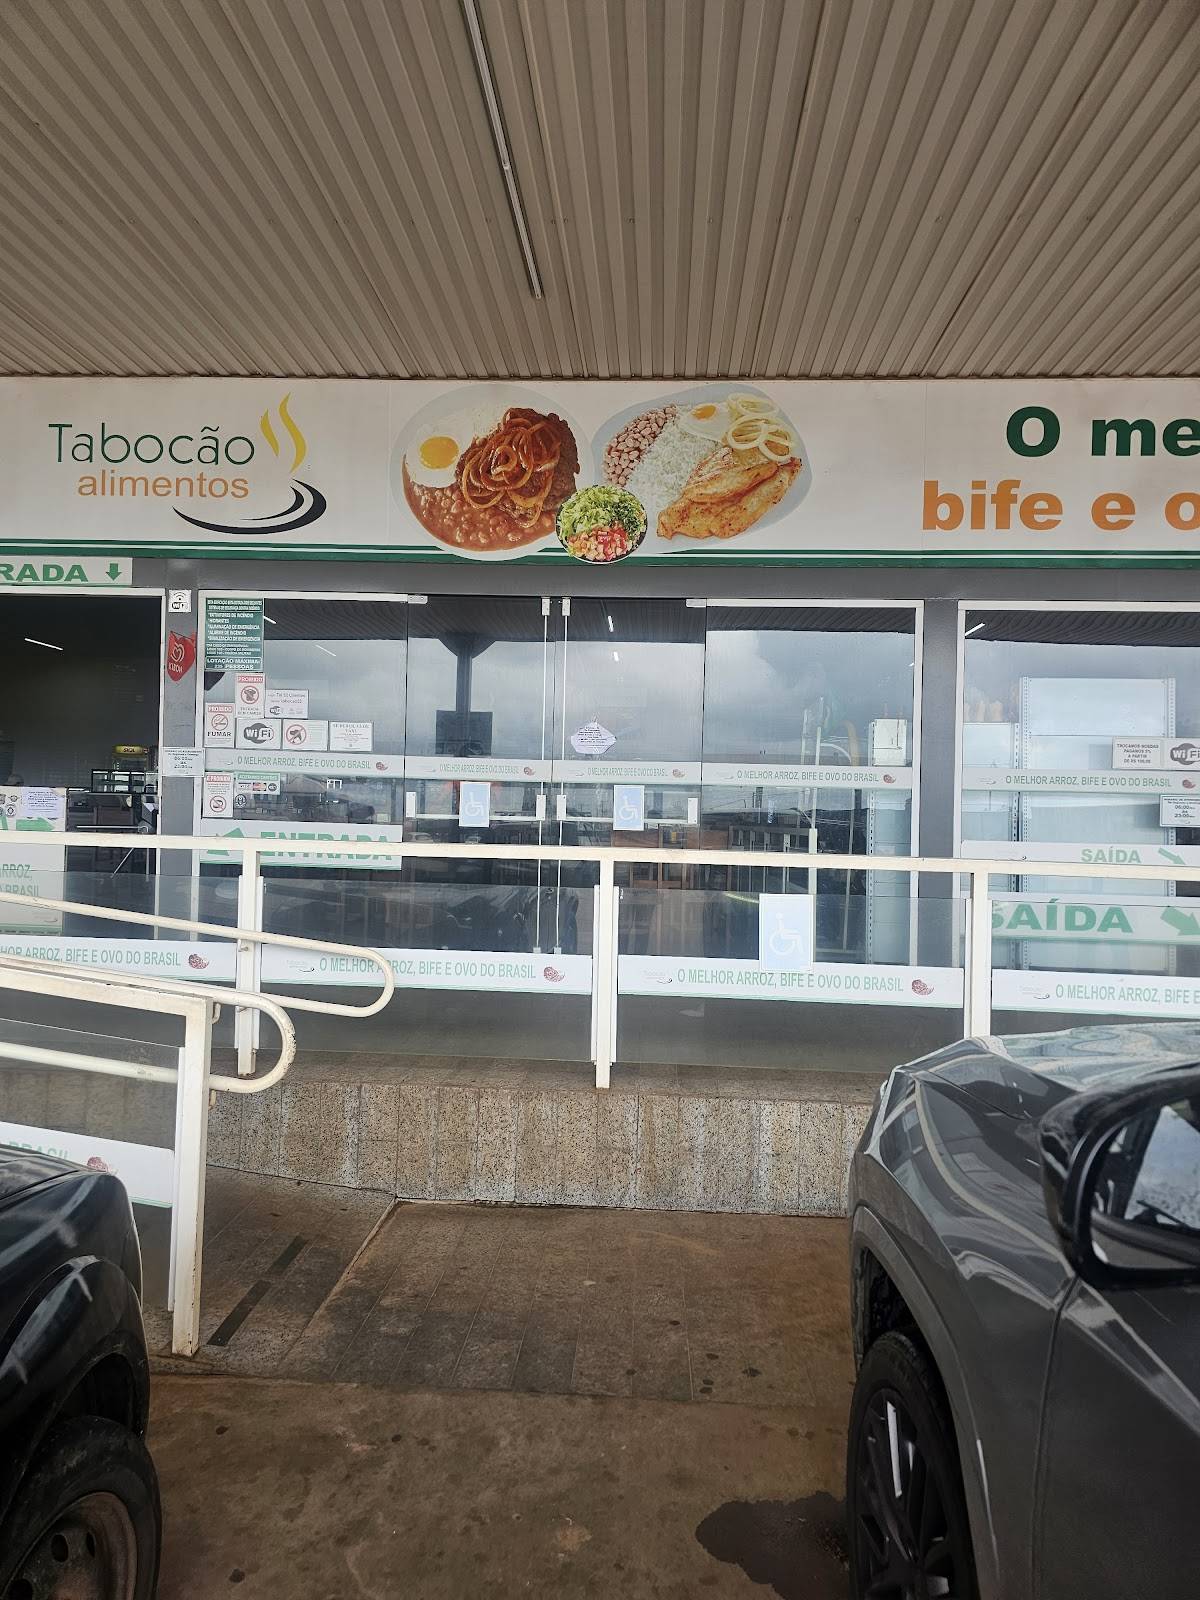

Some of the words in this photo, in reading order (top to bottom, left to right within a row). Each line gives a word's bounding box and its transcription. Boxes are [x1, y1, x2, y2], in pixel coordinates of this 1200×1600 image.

[1006, 405, 1061, 457] O
[48, 422, 255, 465] Tabocão
[77, 469, 250, 499] alimentos
[922, 479, 1063, 531] bife
[1091, 492, 1136, 531] e
[737, 770, 742, 779] O
[744, 771, 772, 779] MELHOR
[802, 772, 818, 780] BIFE
[819, 772, 823, 780] E
[825, 772, 841, 781] OVO
[842, 773, 853, 781] DO
[854, 773, 879, 782] BRASIL
[1006, 776, 1012, 784] O
[1014, 776, 1048, 785] MELHOR
[1082, 777, 1099, 785] BIFE
[1101, 778, 1107, 786] E
[1109, 778, 1127, 786] OVO
[1128, 778, 1140, 787] DO
[1142, 778, 1172, 787] BRASIL
[1081, 846, 1141, 863] SAÍDA
[66, 948, 89, 962] BIFE
[92, 949, 98, 962] E
[101, 950, 122, 964] OVO
[127, 950, 140, 964] DO
[144, 952, 181, 966] BRASIL
[320, 958, 327, 971] O
[330, 958, 374, 972] MELHOR
[419, 960, 442, 975] BIFE
[446, 962, 452, 976] E
[455, 962, 477, 976] OVO
[481, 963, 495, 977] DO
[498, 964, 536, 978] BRASIL
[678, 969, 686, 982] O
[688, 969, 734, 984] MELHOR
[736, 971, 777, 988] ARROZ,
[780, 973, 804, 987] BIFE
[808, 974, 814, 988] E
[818, 974, 841, 988] OVO
[845, 976, 860, 989] DO
[864, 976, 903, 992] BRASIL
[1056, 984, 1064, 998] O
[1067, 985, 1115, 1000] MELHOR
[1118, 986, 1160, 1005] ARROZ,
[1165, 988, 1189, 1004] BIFE
